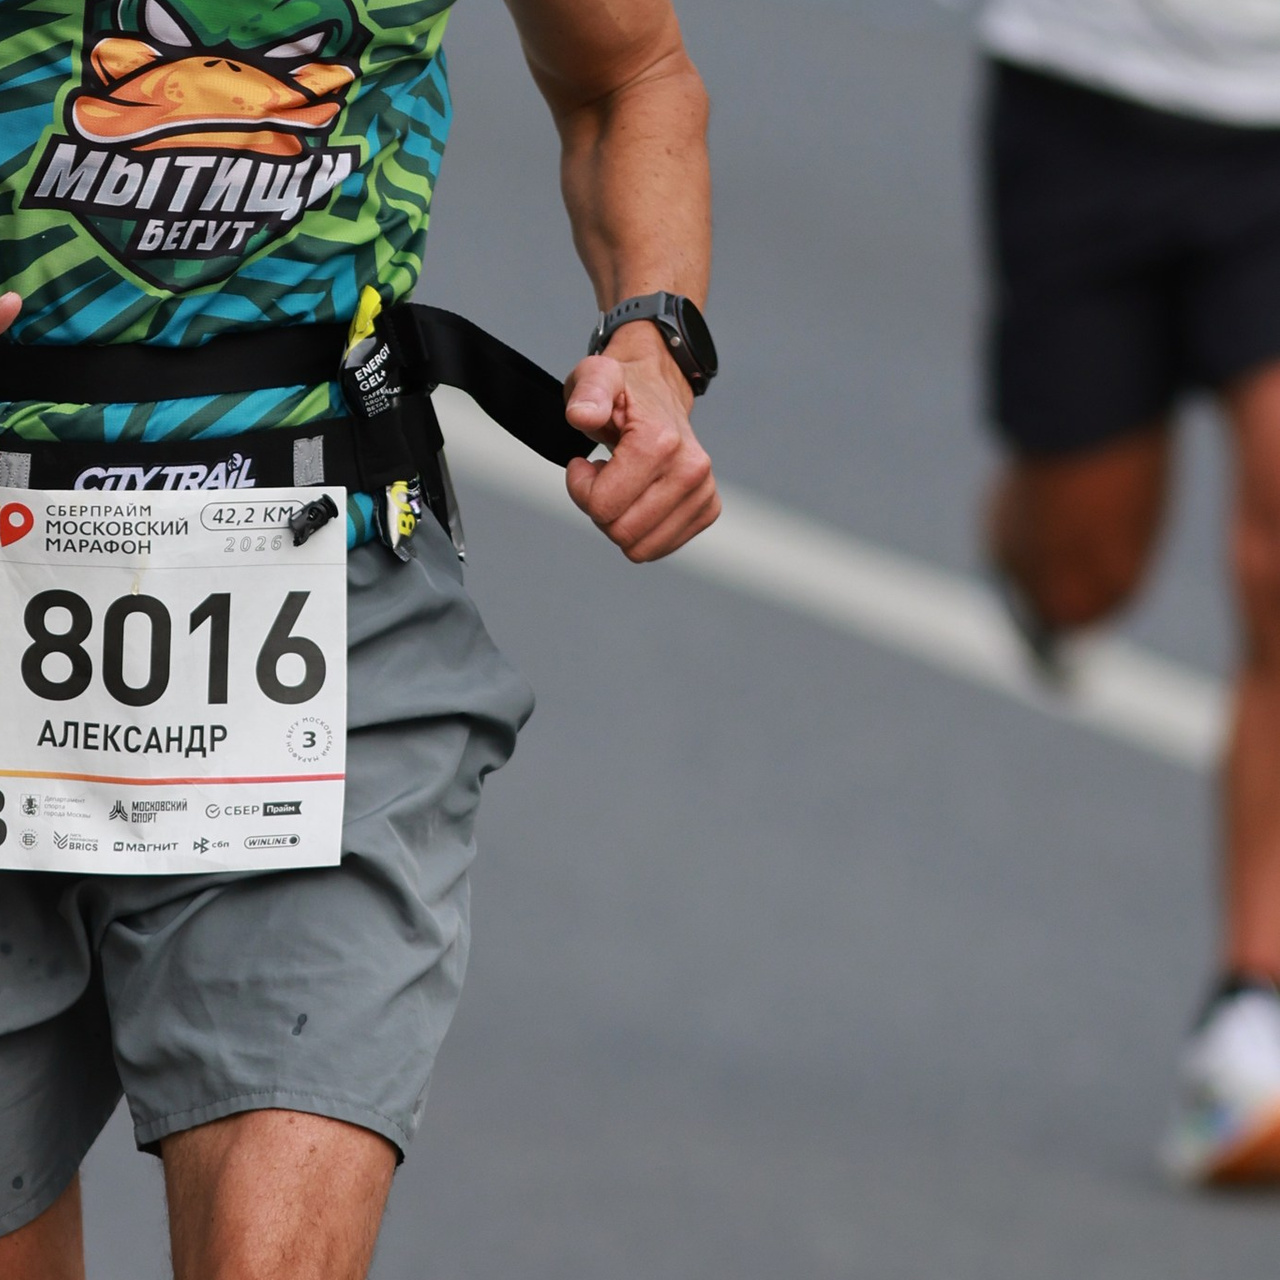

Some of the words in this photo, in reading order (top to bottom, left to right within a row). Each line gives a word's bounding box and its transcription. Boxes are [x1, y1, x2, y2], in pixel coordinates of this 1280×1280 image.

[34, 143, 352, 220] МЫТИЩИ
[137, 219, 255, 251] БЕГУТ
[355, 343, 390, 381] ENERGY
[359, 370, 386, 391] GEL+
[74, 466, 163, 490] CITY
[46, 503, 152, 517] СБЕРПРАЙМ
[212, 507, 255, 526] 42,2
[46, 517, 189, 536] МОСКОВСКИЙ
[46, 538, 152, 554] МАРАФОН
[224, 535, 283, 552] 2026
[37, 720, 228, 758] АЛЕКСАНДР
[302, 730, 317, 749] 3
[131, 798, 188, 812] МОСКОВСКИЙ
[224, 805, 260, 816] СБЕР
[266, 803, 296, 815] Прайм
[131, 812, 157, 823] СПОРТ
[69, 842, 98, 851] BRICS
[211, 841, 230, 849] сбп
[247, 837, 288, 847] WINLINE
